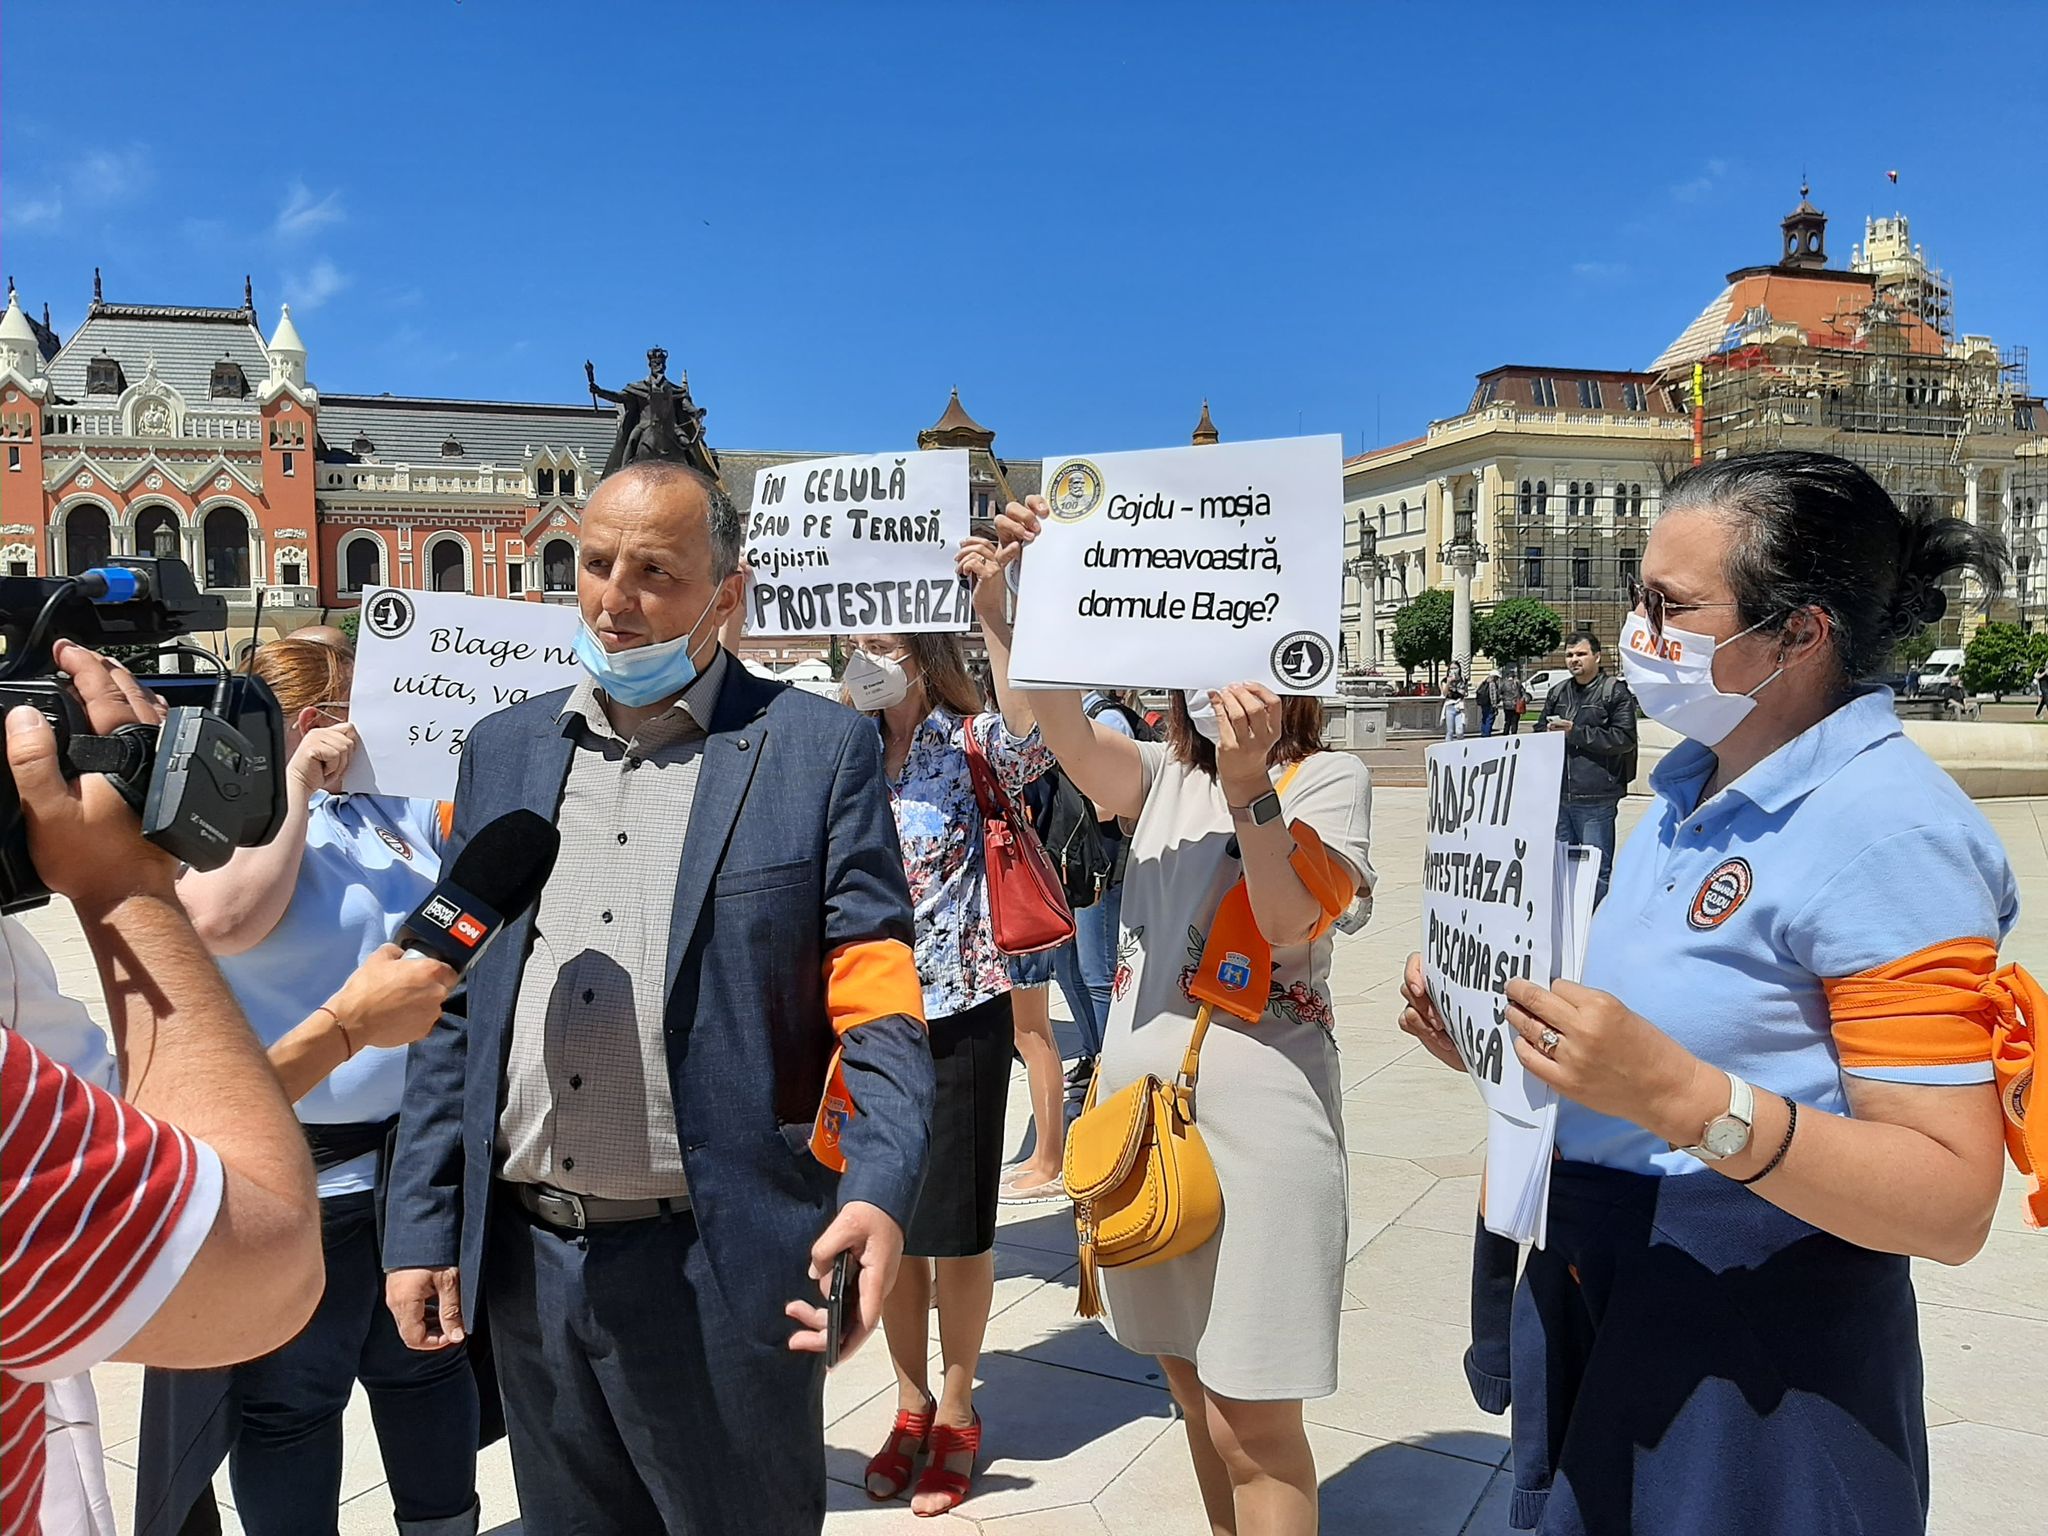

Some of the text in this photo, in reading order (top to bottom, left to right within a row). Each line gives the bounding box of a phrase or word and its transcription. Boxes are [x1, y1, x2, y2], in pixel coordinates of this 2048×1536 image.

[761, 458, 906, 505] ÎN CELULĂ
[1107, 493, 1174, 527] Gojdu
[1200, 486, 1271, 527] moșia
[749, 509, 946, 549] SAU PE TERASĂ,
[1084, 536, 1282, 575] dumneavoastră,
[1078, 589, 1280, 629] domnule Blage?
[429, 627, 537, 668] Blage
[393, 673, 476, 705] uita,
[408, 720, 443, 747] și
[458, 921, 481, 939] CNN
